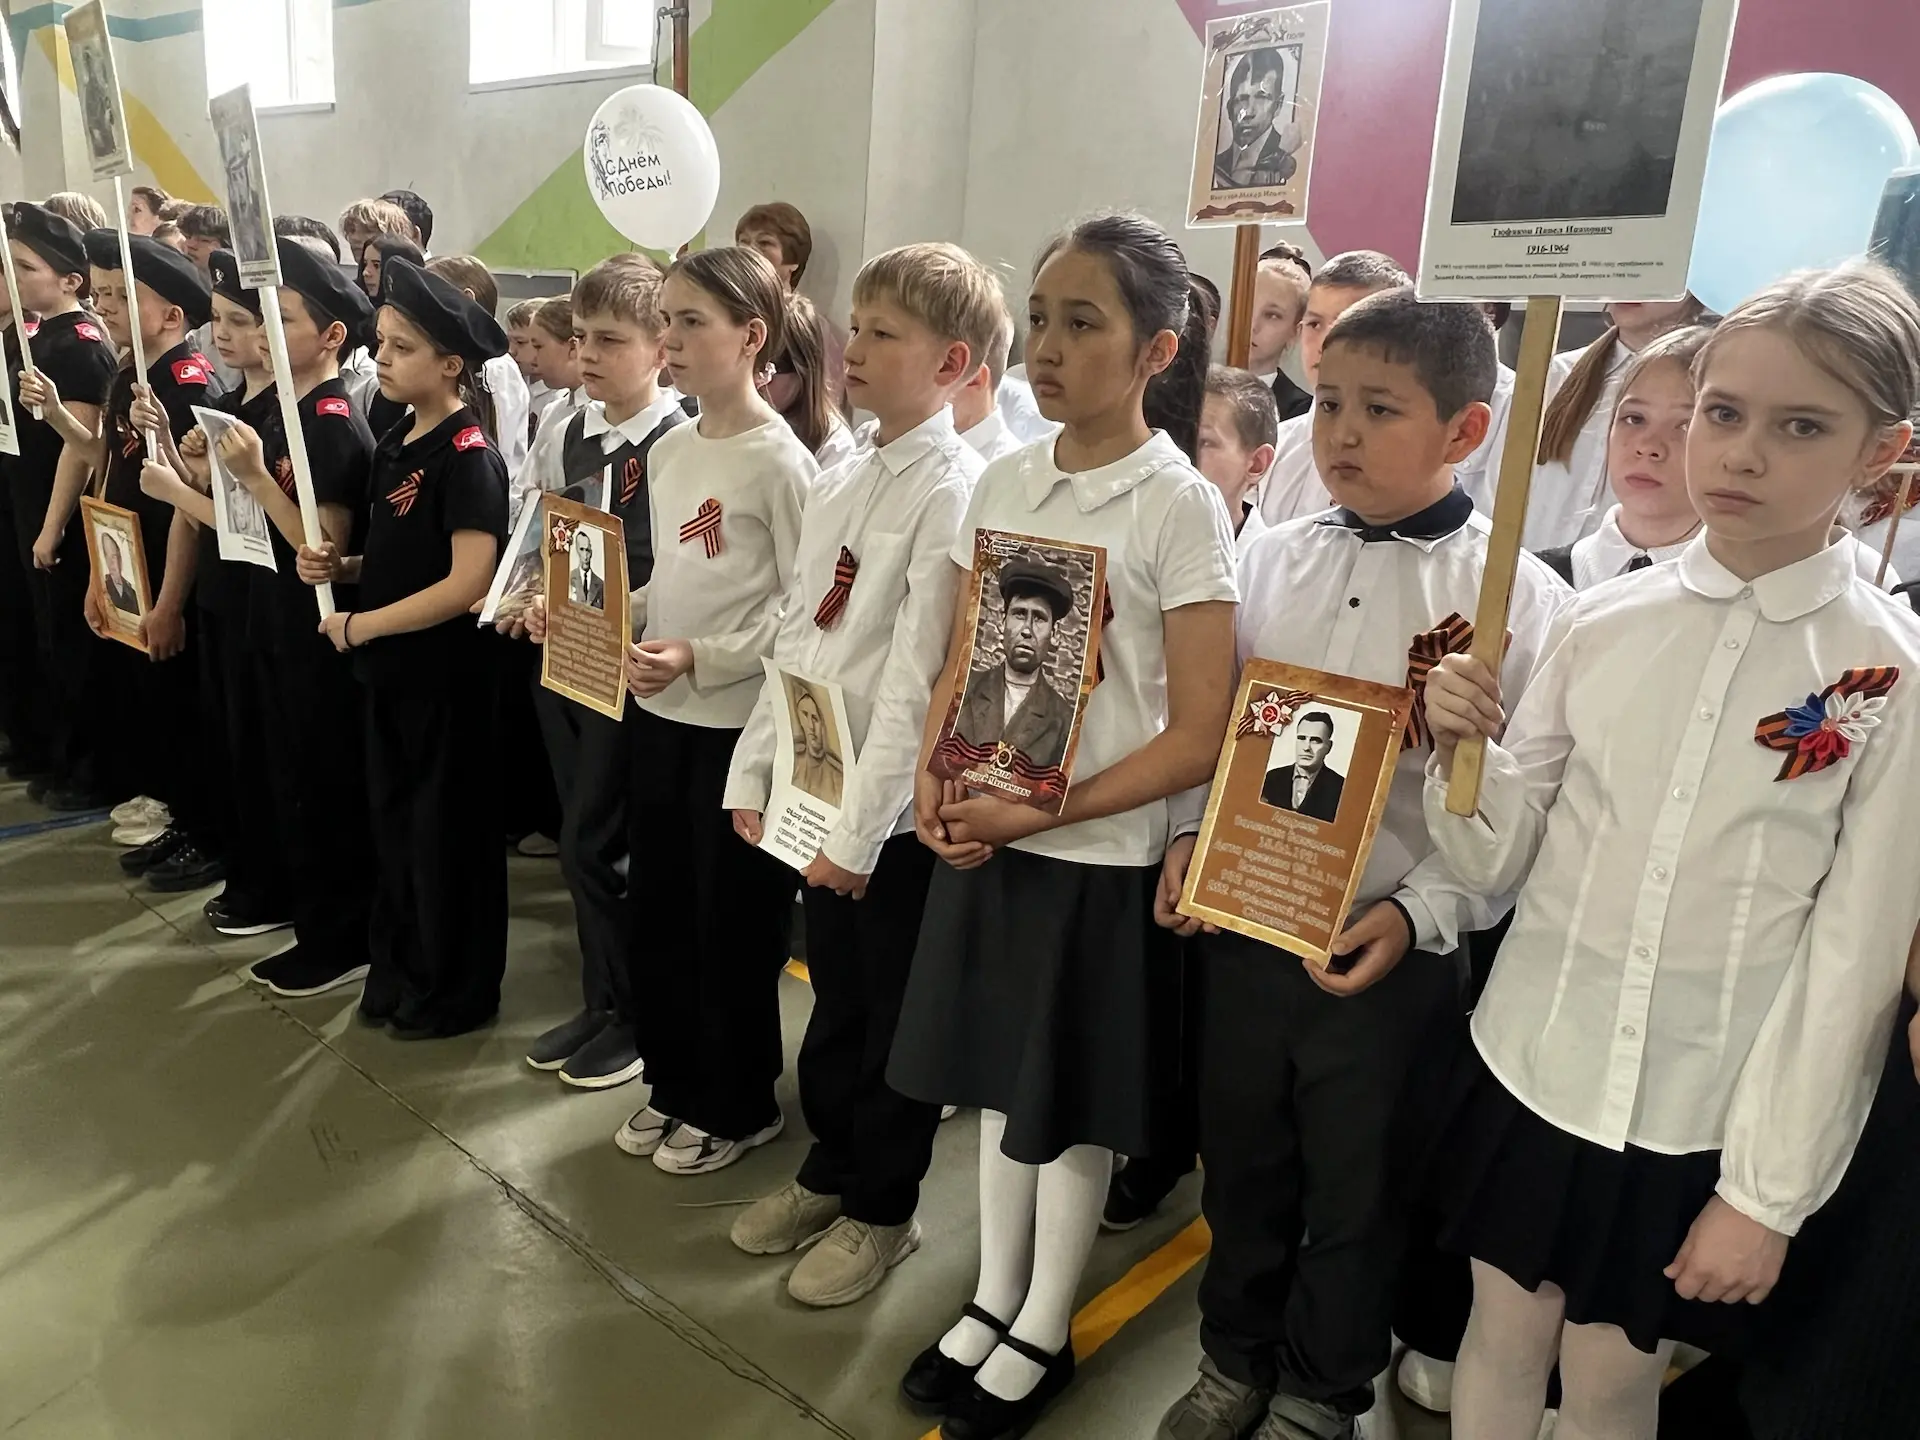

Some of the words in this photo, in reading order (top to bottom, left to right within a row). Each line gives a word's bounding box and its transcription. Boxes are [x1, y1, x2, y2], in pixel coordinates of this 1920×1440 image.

[618, 151, 661, 176] Днём
[608, 169, 672, 197] Победы!
[1535, 226, 1563, 235] Павел
